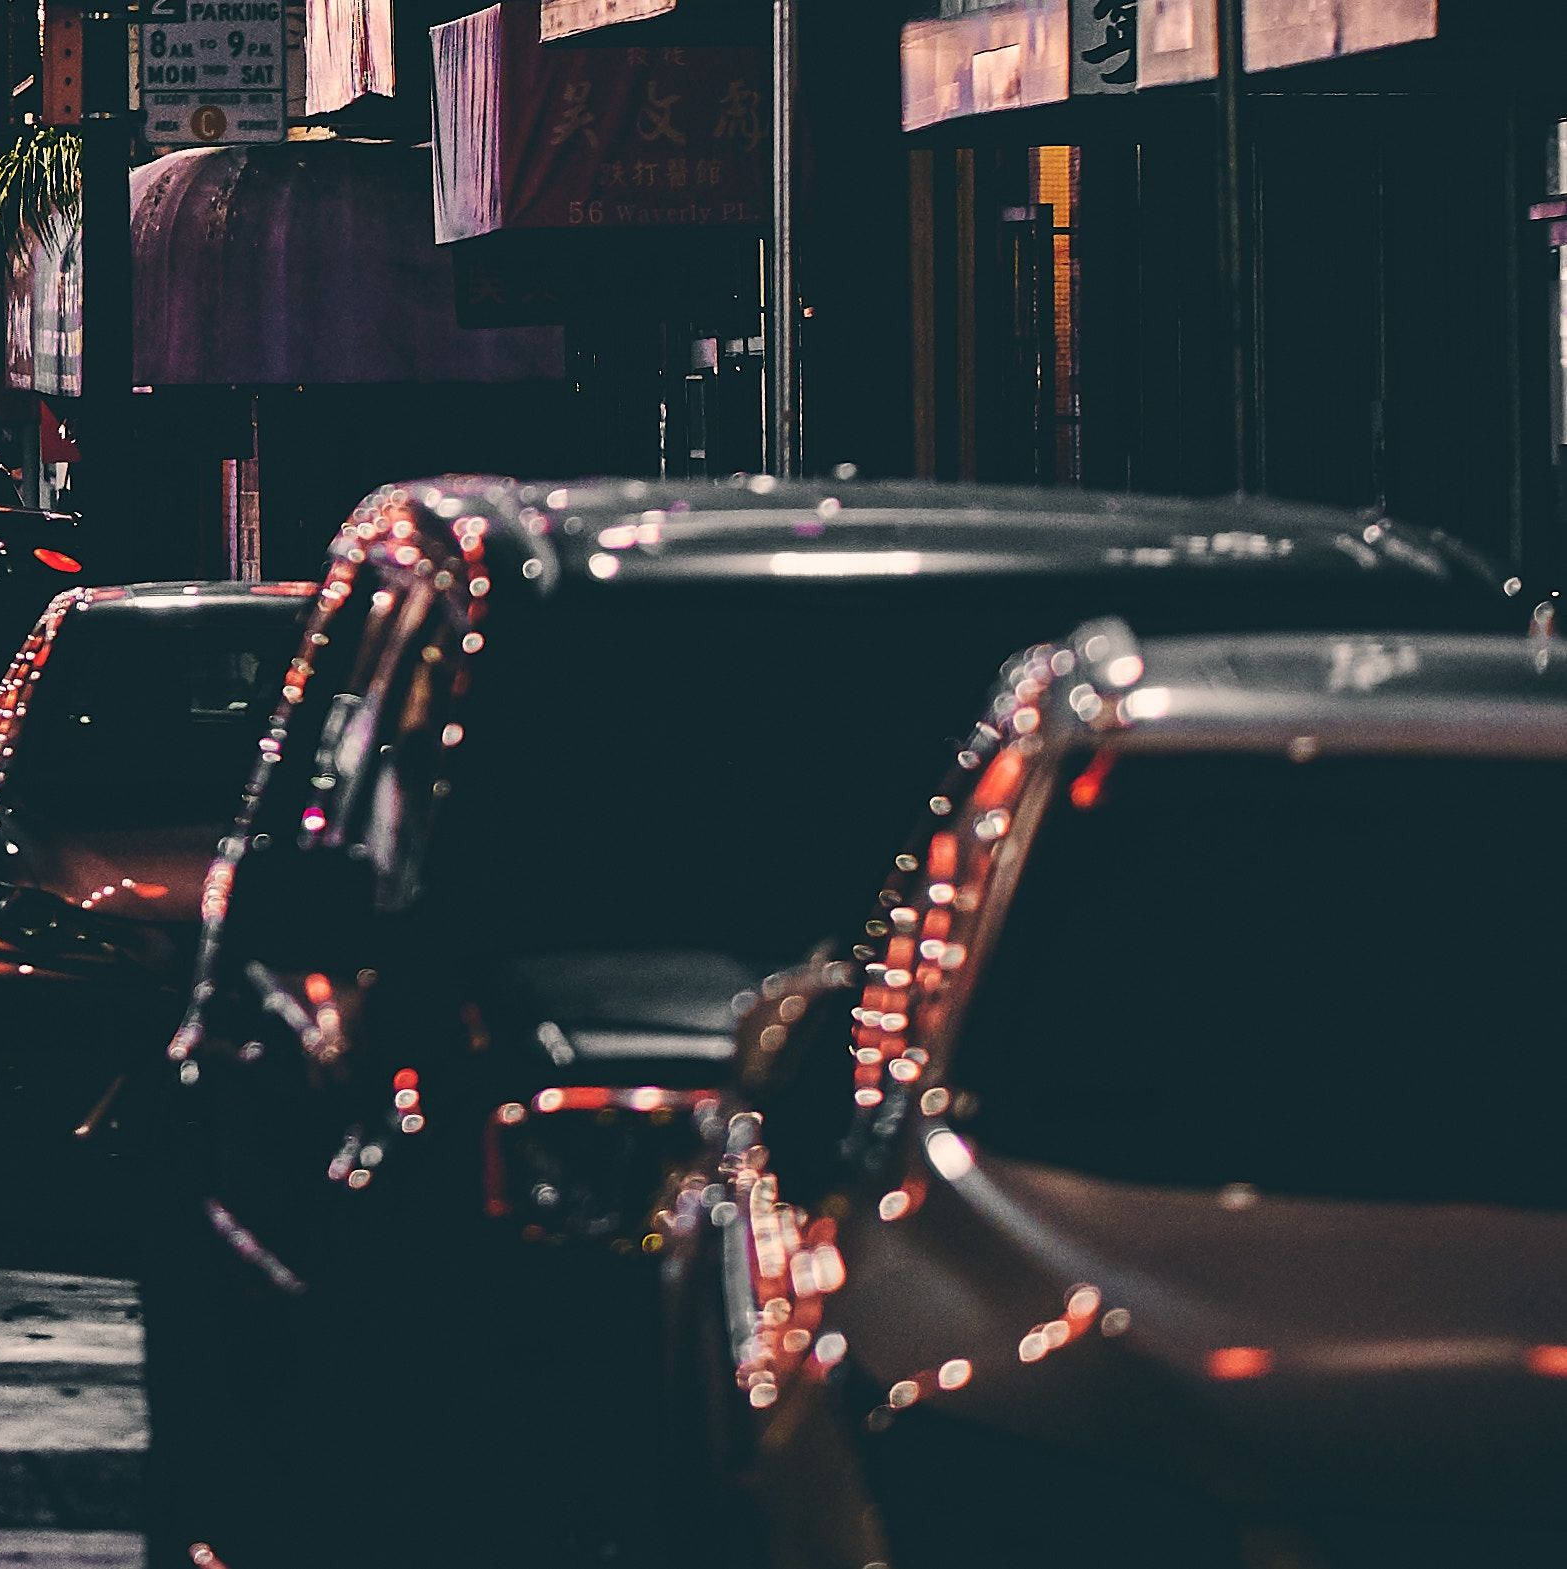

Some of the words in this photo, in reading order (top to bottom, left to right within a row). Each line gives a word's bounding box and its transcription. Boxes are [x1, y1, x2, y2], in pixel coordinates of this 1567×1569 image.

[190, 2, 279, 21] PARKING
[150, 30, 166, 57] 8
[227, 30, 244, 58] 9
[147, 65, 196, 83] MON
[241, 65, 274, 84] SAT
[569, 199, 603, 224] 56
[616, 201, 714, 225] Waverly
